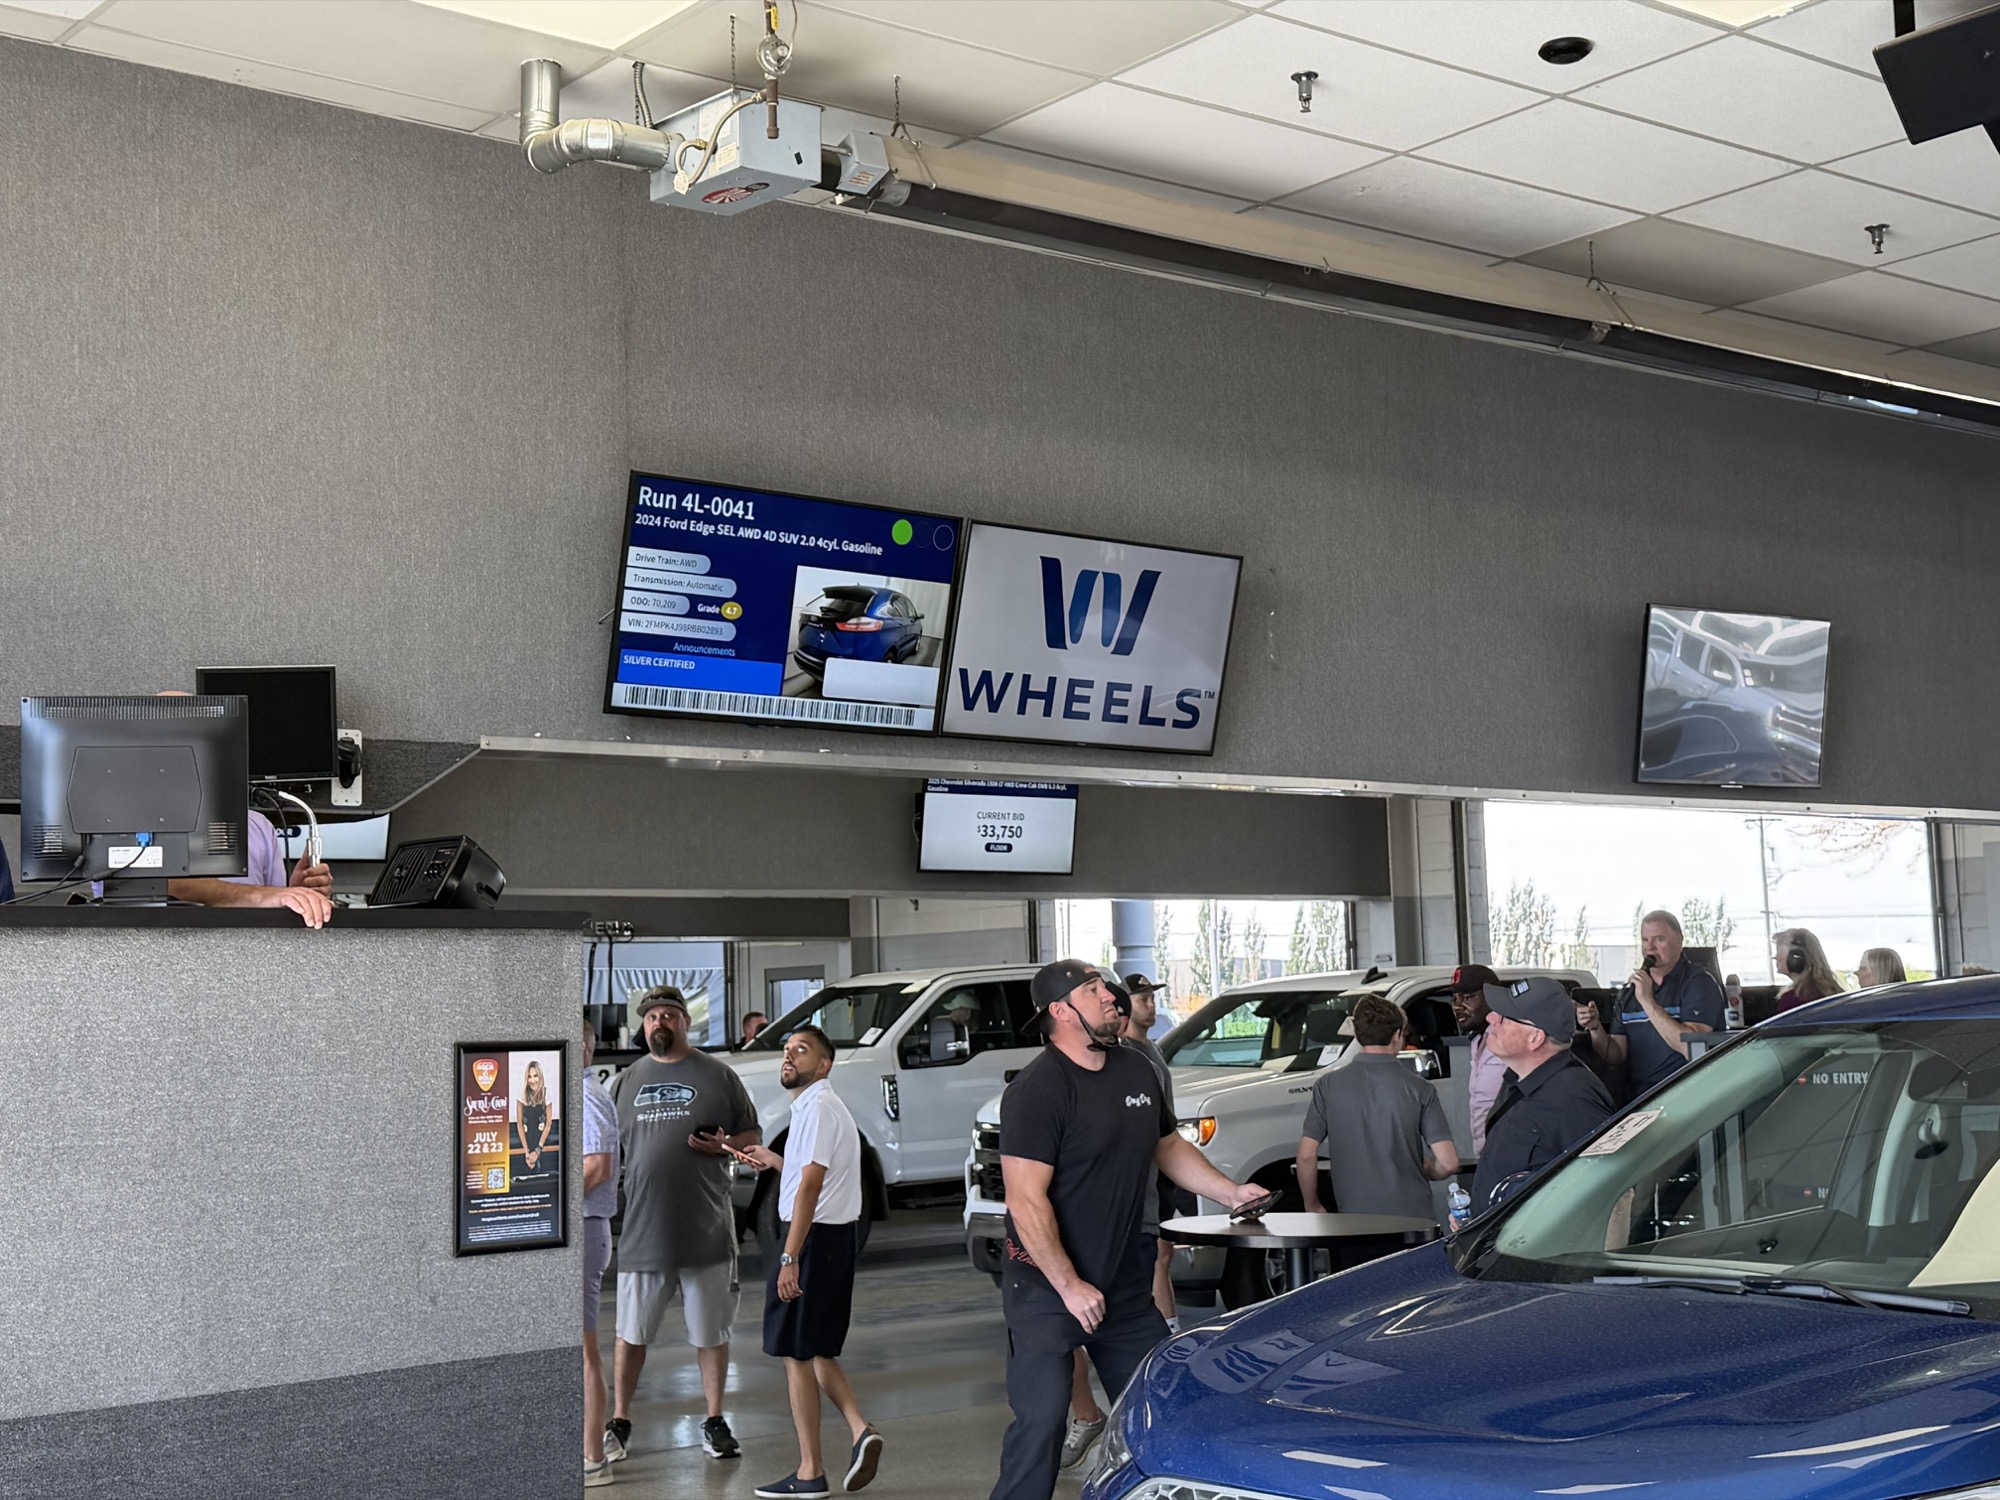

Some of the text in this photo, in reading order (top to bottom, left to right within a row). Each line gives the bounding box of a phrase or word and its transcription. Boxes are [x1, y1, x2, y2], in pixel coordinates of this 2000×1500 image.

[638, 485, 755, 520] Run 4L-0041
[635, 513, 661, 527] 2024
[663, 517, 688, 531] Ford
[690, 520, 715, 536] Edge
[717, 523, 736, 537] SEL
[737, 526, 761, 540] AWD
[762, 529, 777, 542] 4D
[778, 531, 799, 545] SUV
[800, 534, 816, 547] 2.0
[841, 540, 883, 555] Gasoline
[635, 553, 698, 568] Drive Train: AWD
[633, 573, 724, 592] Transmission: Automatic
[630, 596, 677, 609] ODO: 70,209
[697, 603, 720, 614] Grade
[627, 618, 644, 628] VIN:
[673, 642, 736, 657] Announcements
[623, 654, 696, 670] SILVER CERTIFIED
[959, 667, 1202, 730] WHEELS
[976, 811, 1025, 821] CURRENT BID
[976, 824, 1023, 841] $33,750
[1812, 1072, 1869, 1085] NO ENTRY
[636, 1109, 691, 1122] SEAHAWKS
[473, 1131, 498, 1143] JULY
[467, 1141, 504, 1154] 22 & 23
